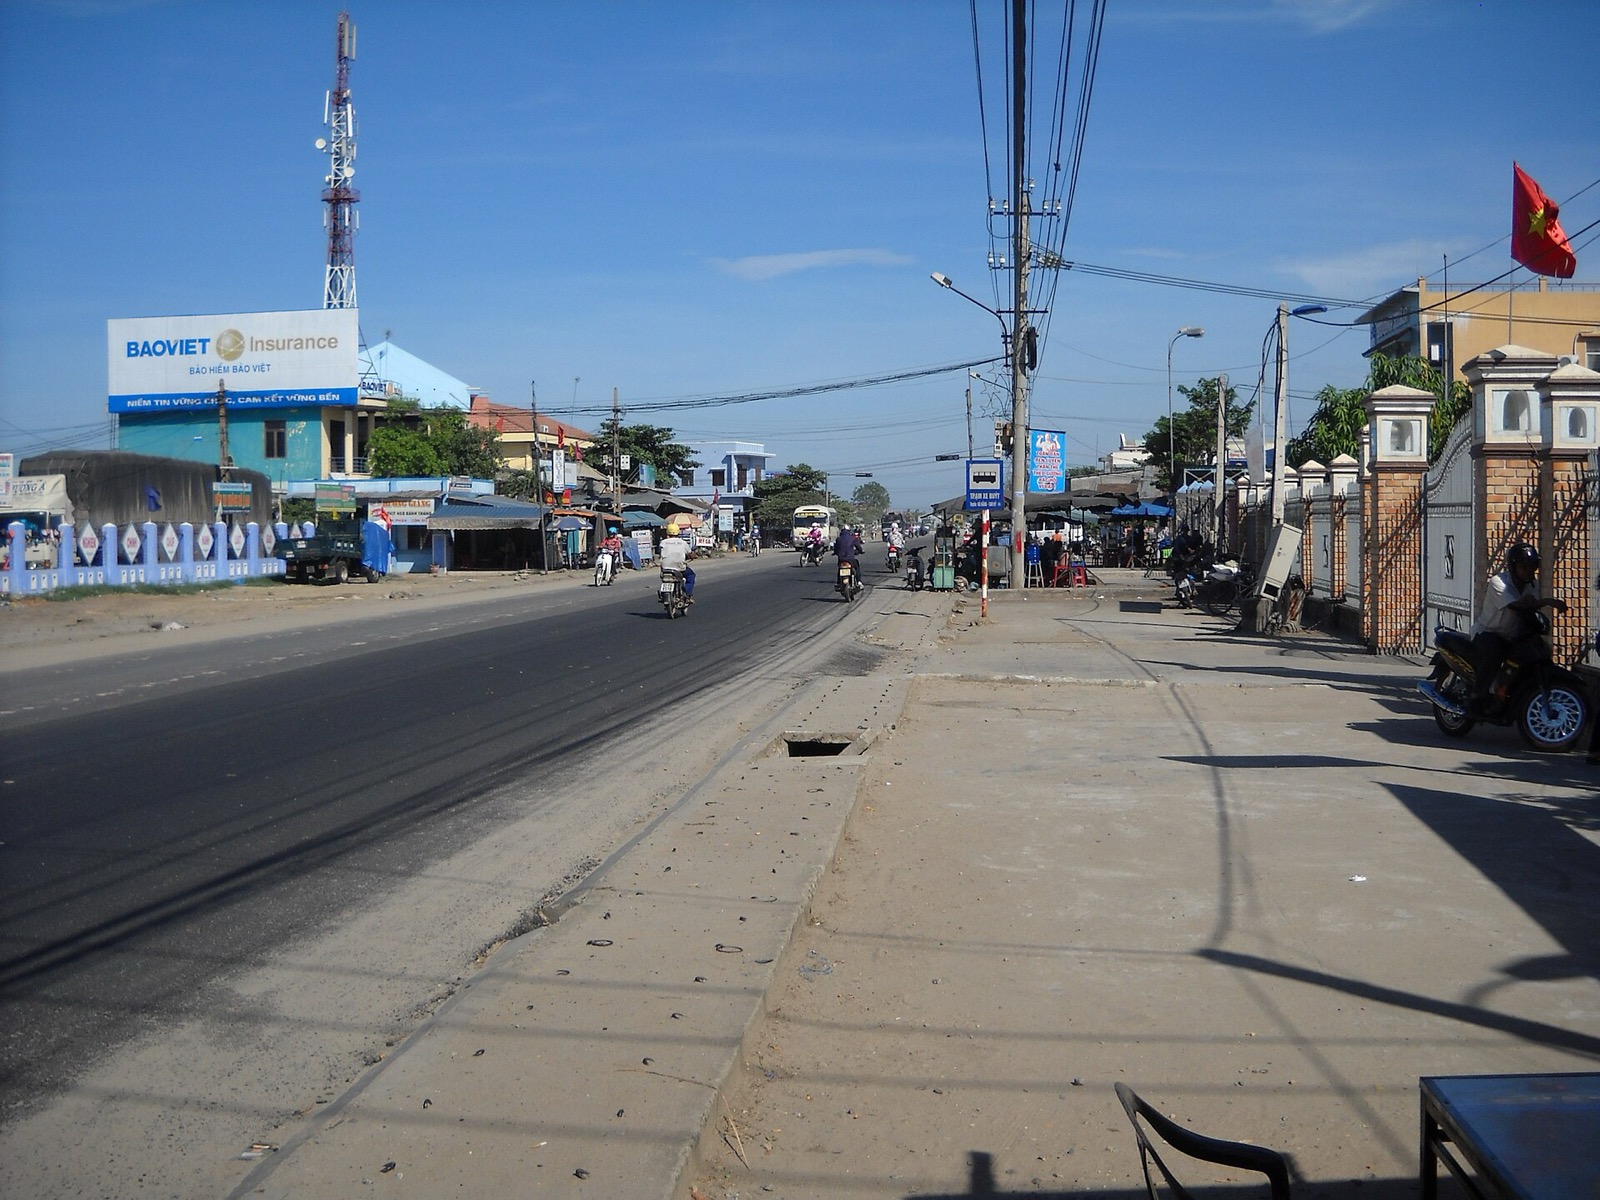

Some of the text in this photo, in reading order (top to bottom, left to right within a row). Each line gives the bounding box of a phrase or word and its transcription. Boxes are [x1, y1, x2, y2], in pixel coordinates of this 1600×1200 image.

[126, 336, 339, 358] BAOVIET Insurance
[204, 397, 236, 405] CHC,
[238, 396, 262, 404] CAM
